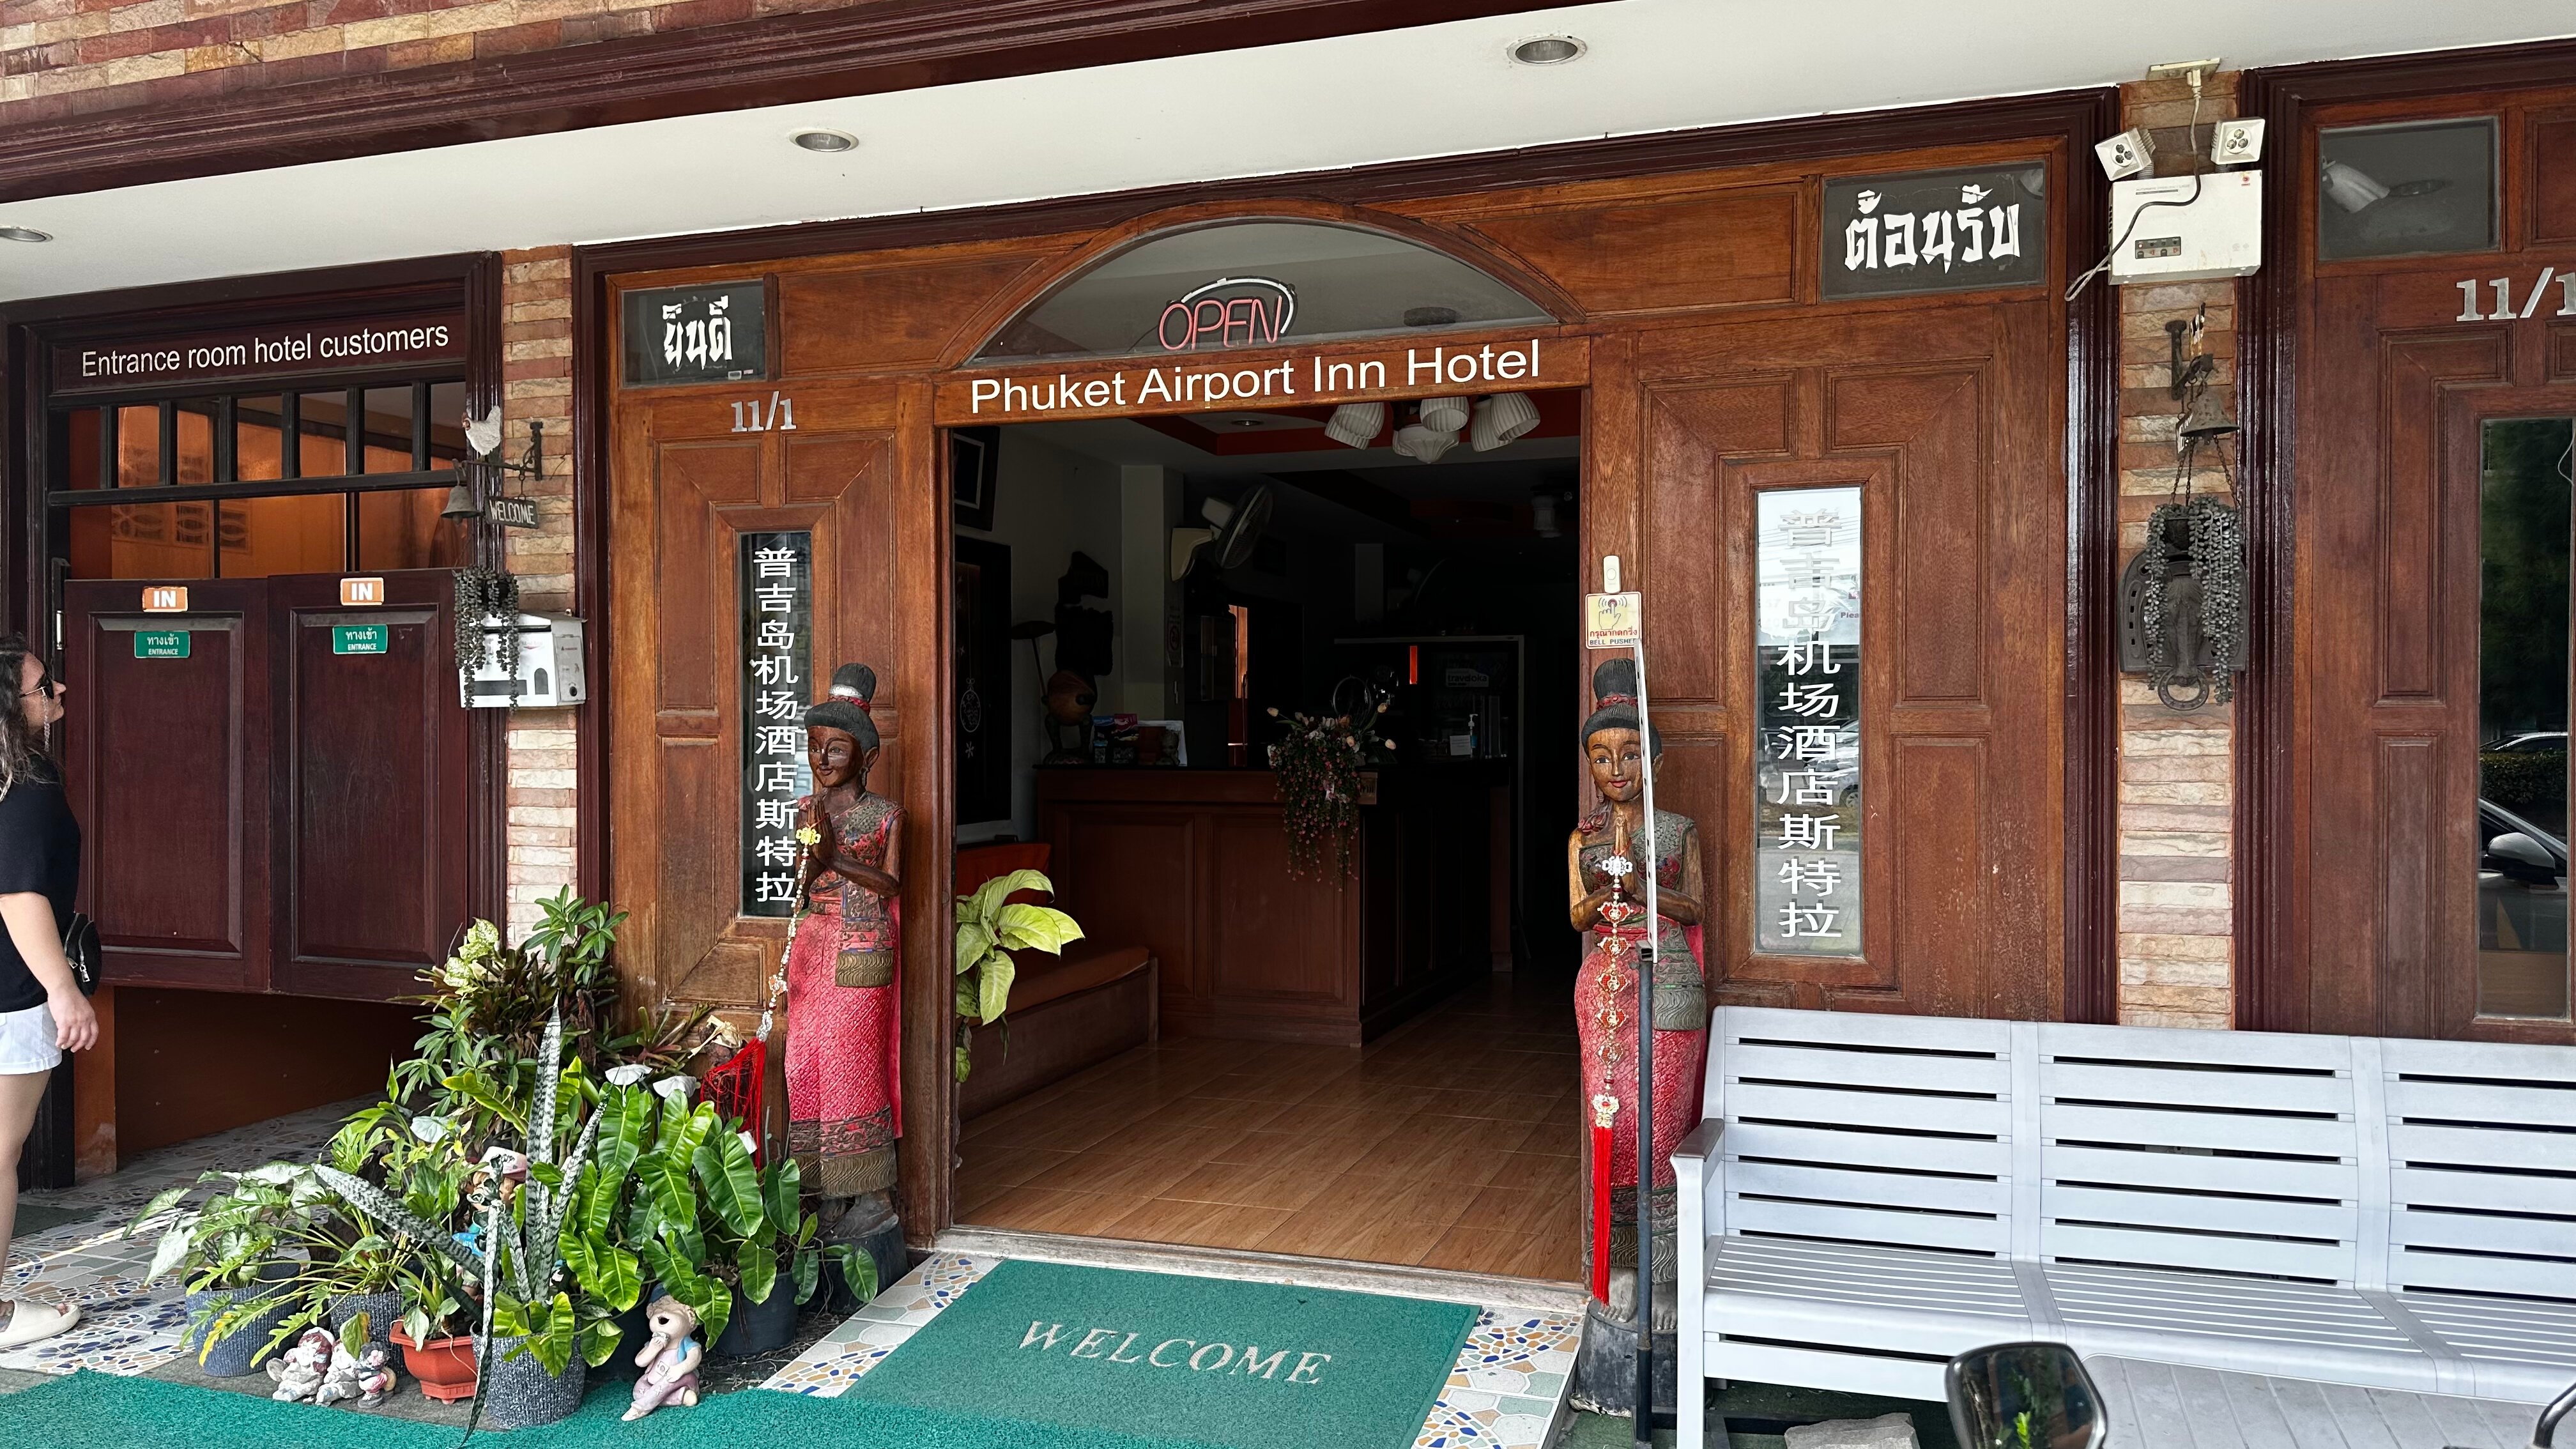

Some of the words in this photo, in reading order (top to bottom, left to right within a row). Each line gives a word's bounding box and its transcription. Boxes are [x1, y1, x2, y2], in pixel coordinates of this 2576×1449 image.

[2457, 267, 2576, 321] 11/1
[1159, 295, 1283, 350] OPEN
[82, 349, 180, 377] Entrance
[188, 345, 246, 368] room
[255, 333, 312, 363] hotel
[320, 325, 448, 358] customers
[972, 371, 1126, 414] Phuket
[1137, 360, 1295, 409] Airport
[1314, 356, 1385, 392] Inn
[1408, 339, 1538, 386] Hotel
[731, 390, 797, 433] 11/1
[489, 499, 536, 525] WELCOME
[153, 590, 176, 608] IN
[351, 583, 373, 601] IN
[147, 632, 179, 645] ทางเข้า
[346, 626, 377, 641] ทางเข้า
[348, 643, 377, 652] ENTRANCE
[753, 546, 799, 903] 普吉岛机场酒店斯特拉
[1777, 509, 1843, 939] 普吉岛机场酒店斯特拉
[1018, 1321, 1332, 1384] WELCOME
